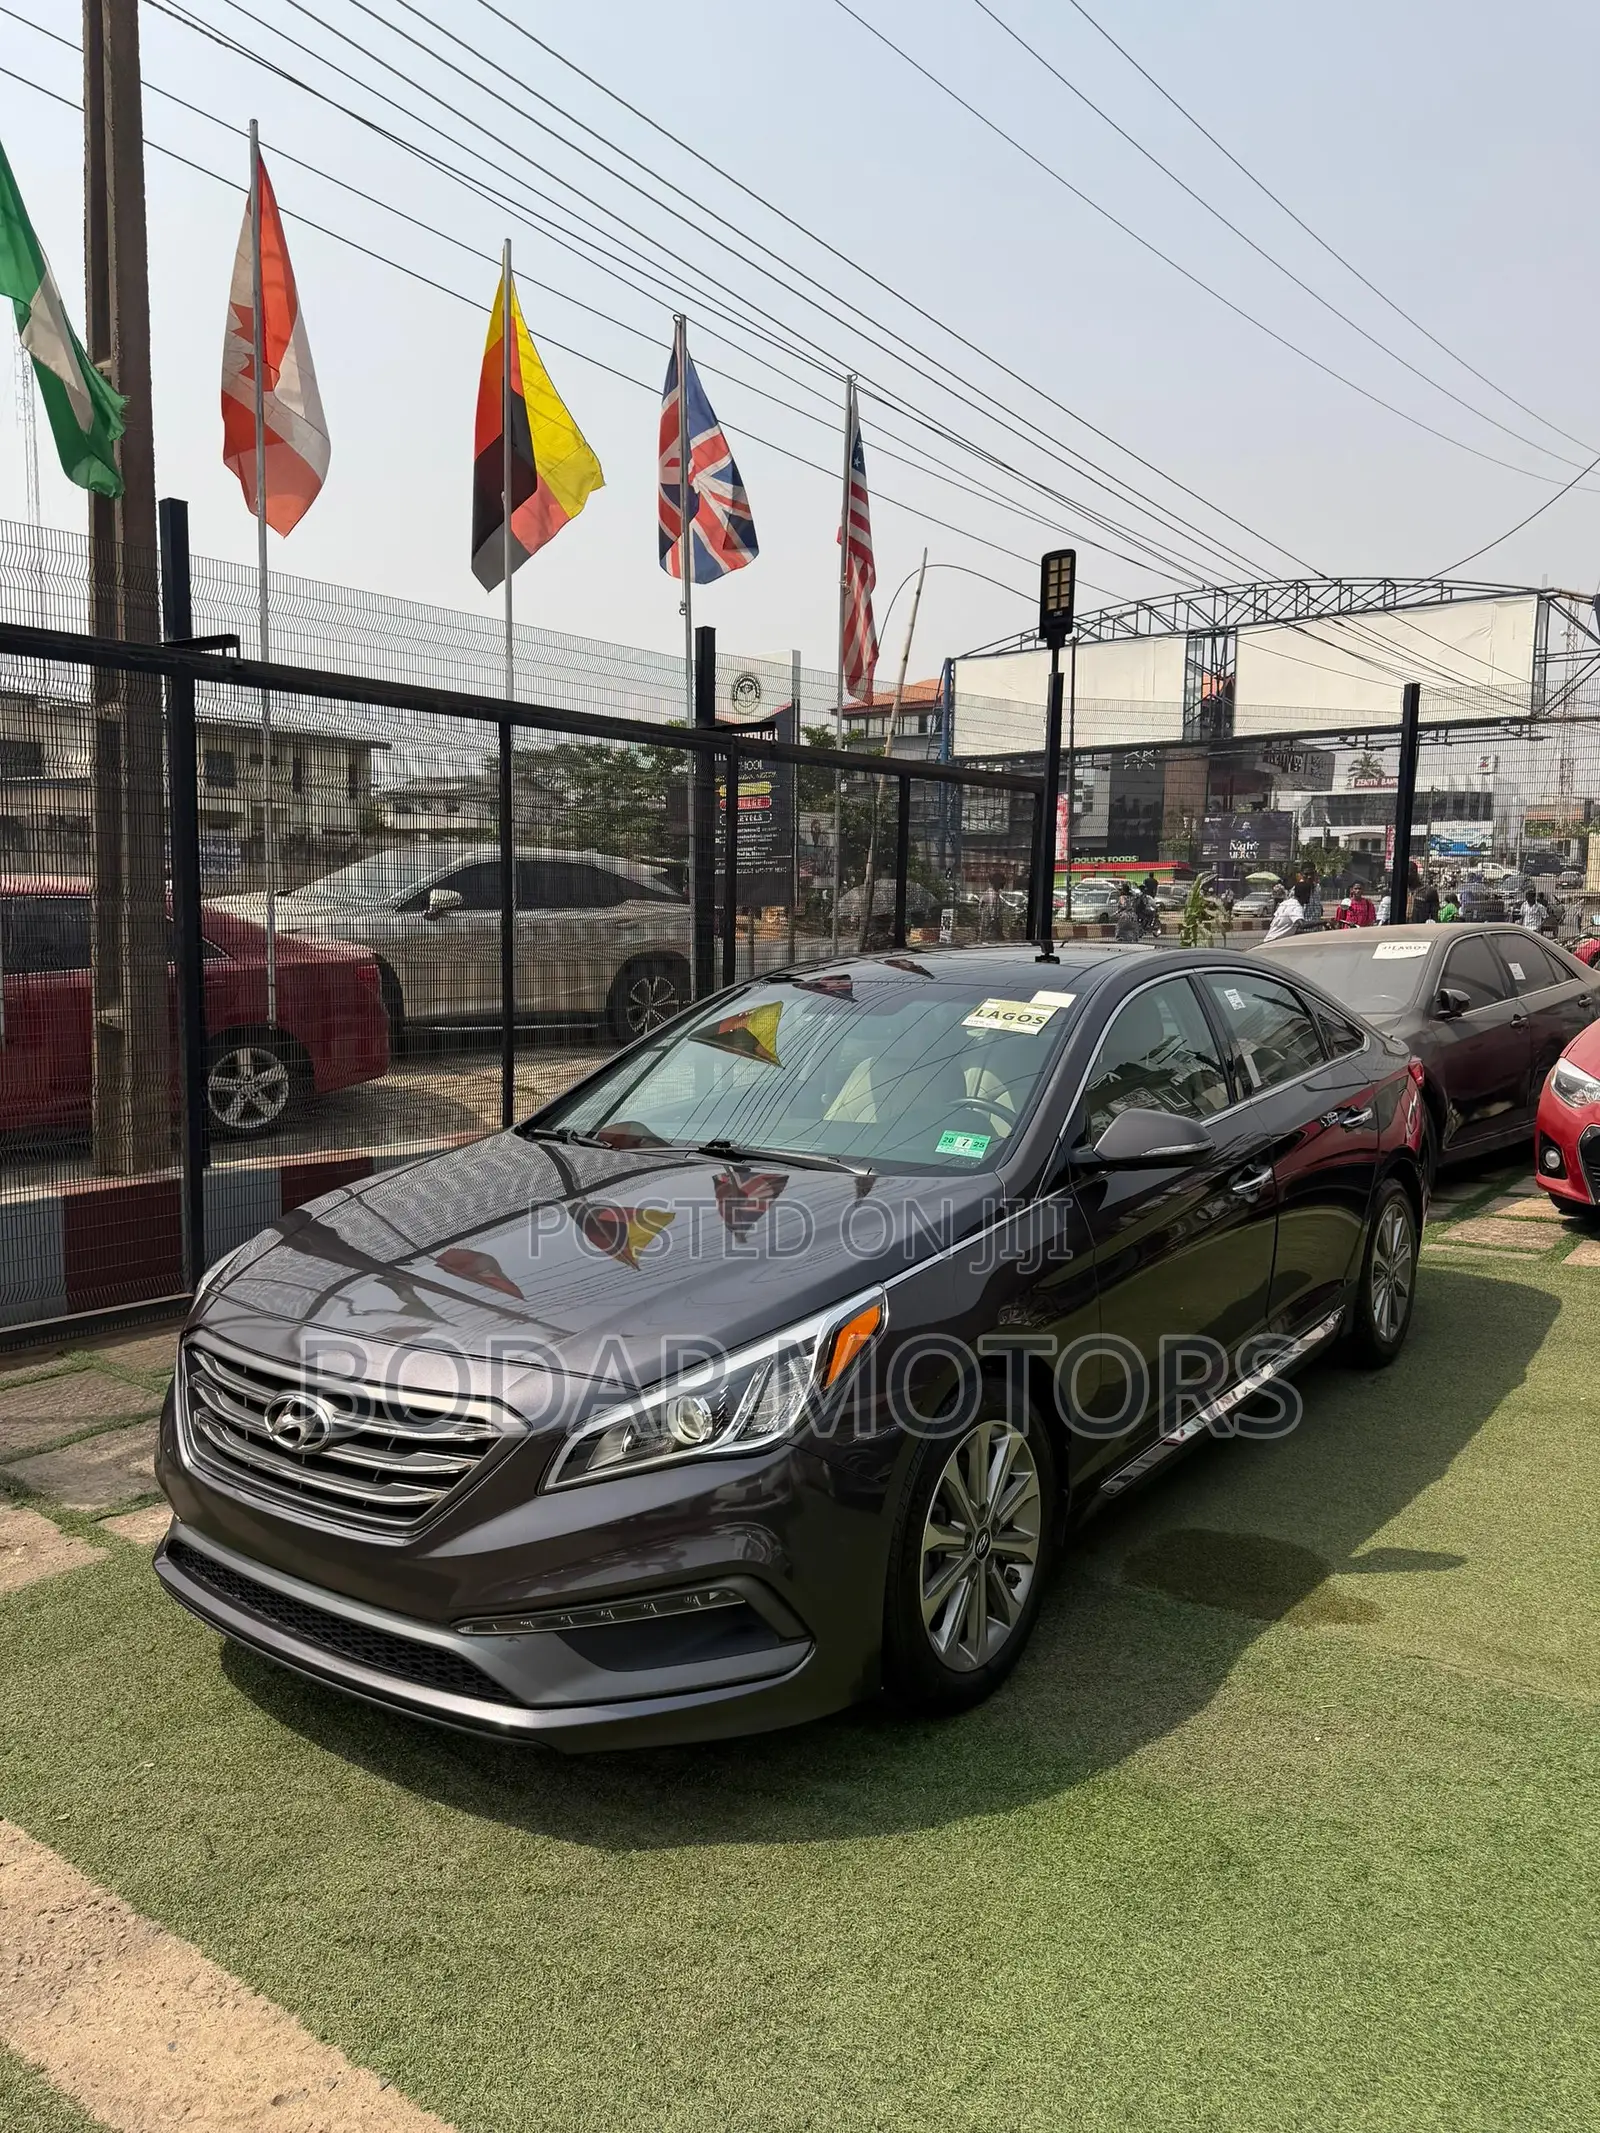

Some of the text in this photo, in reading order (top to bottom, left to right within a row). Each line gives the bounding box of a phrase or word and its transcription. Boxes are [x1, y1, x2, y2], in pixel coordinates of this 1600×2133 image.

[1355, 778, 1378, 787] ZENITH
[1107, 855, 1138, 863] FOODS
[975, 1009, 1046, 1025] LAGOS
[942, 1136, 985, 1149] 20 7 25
